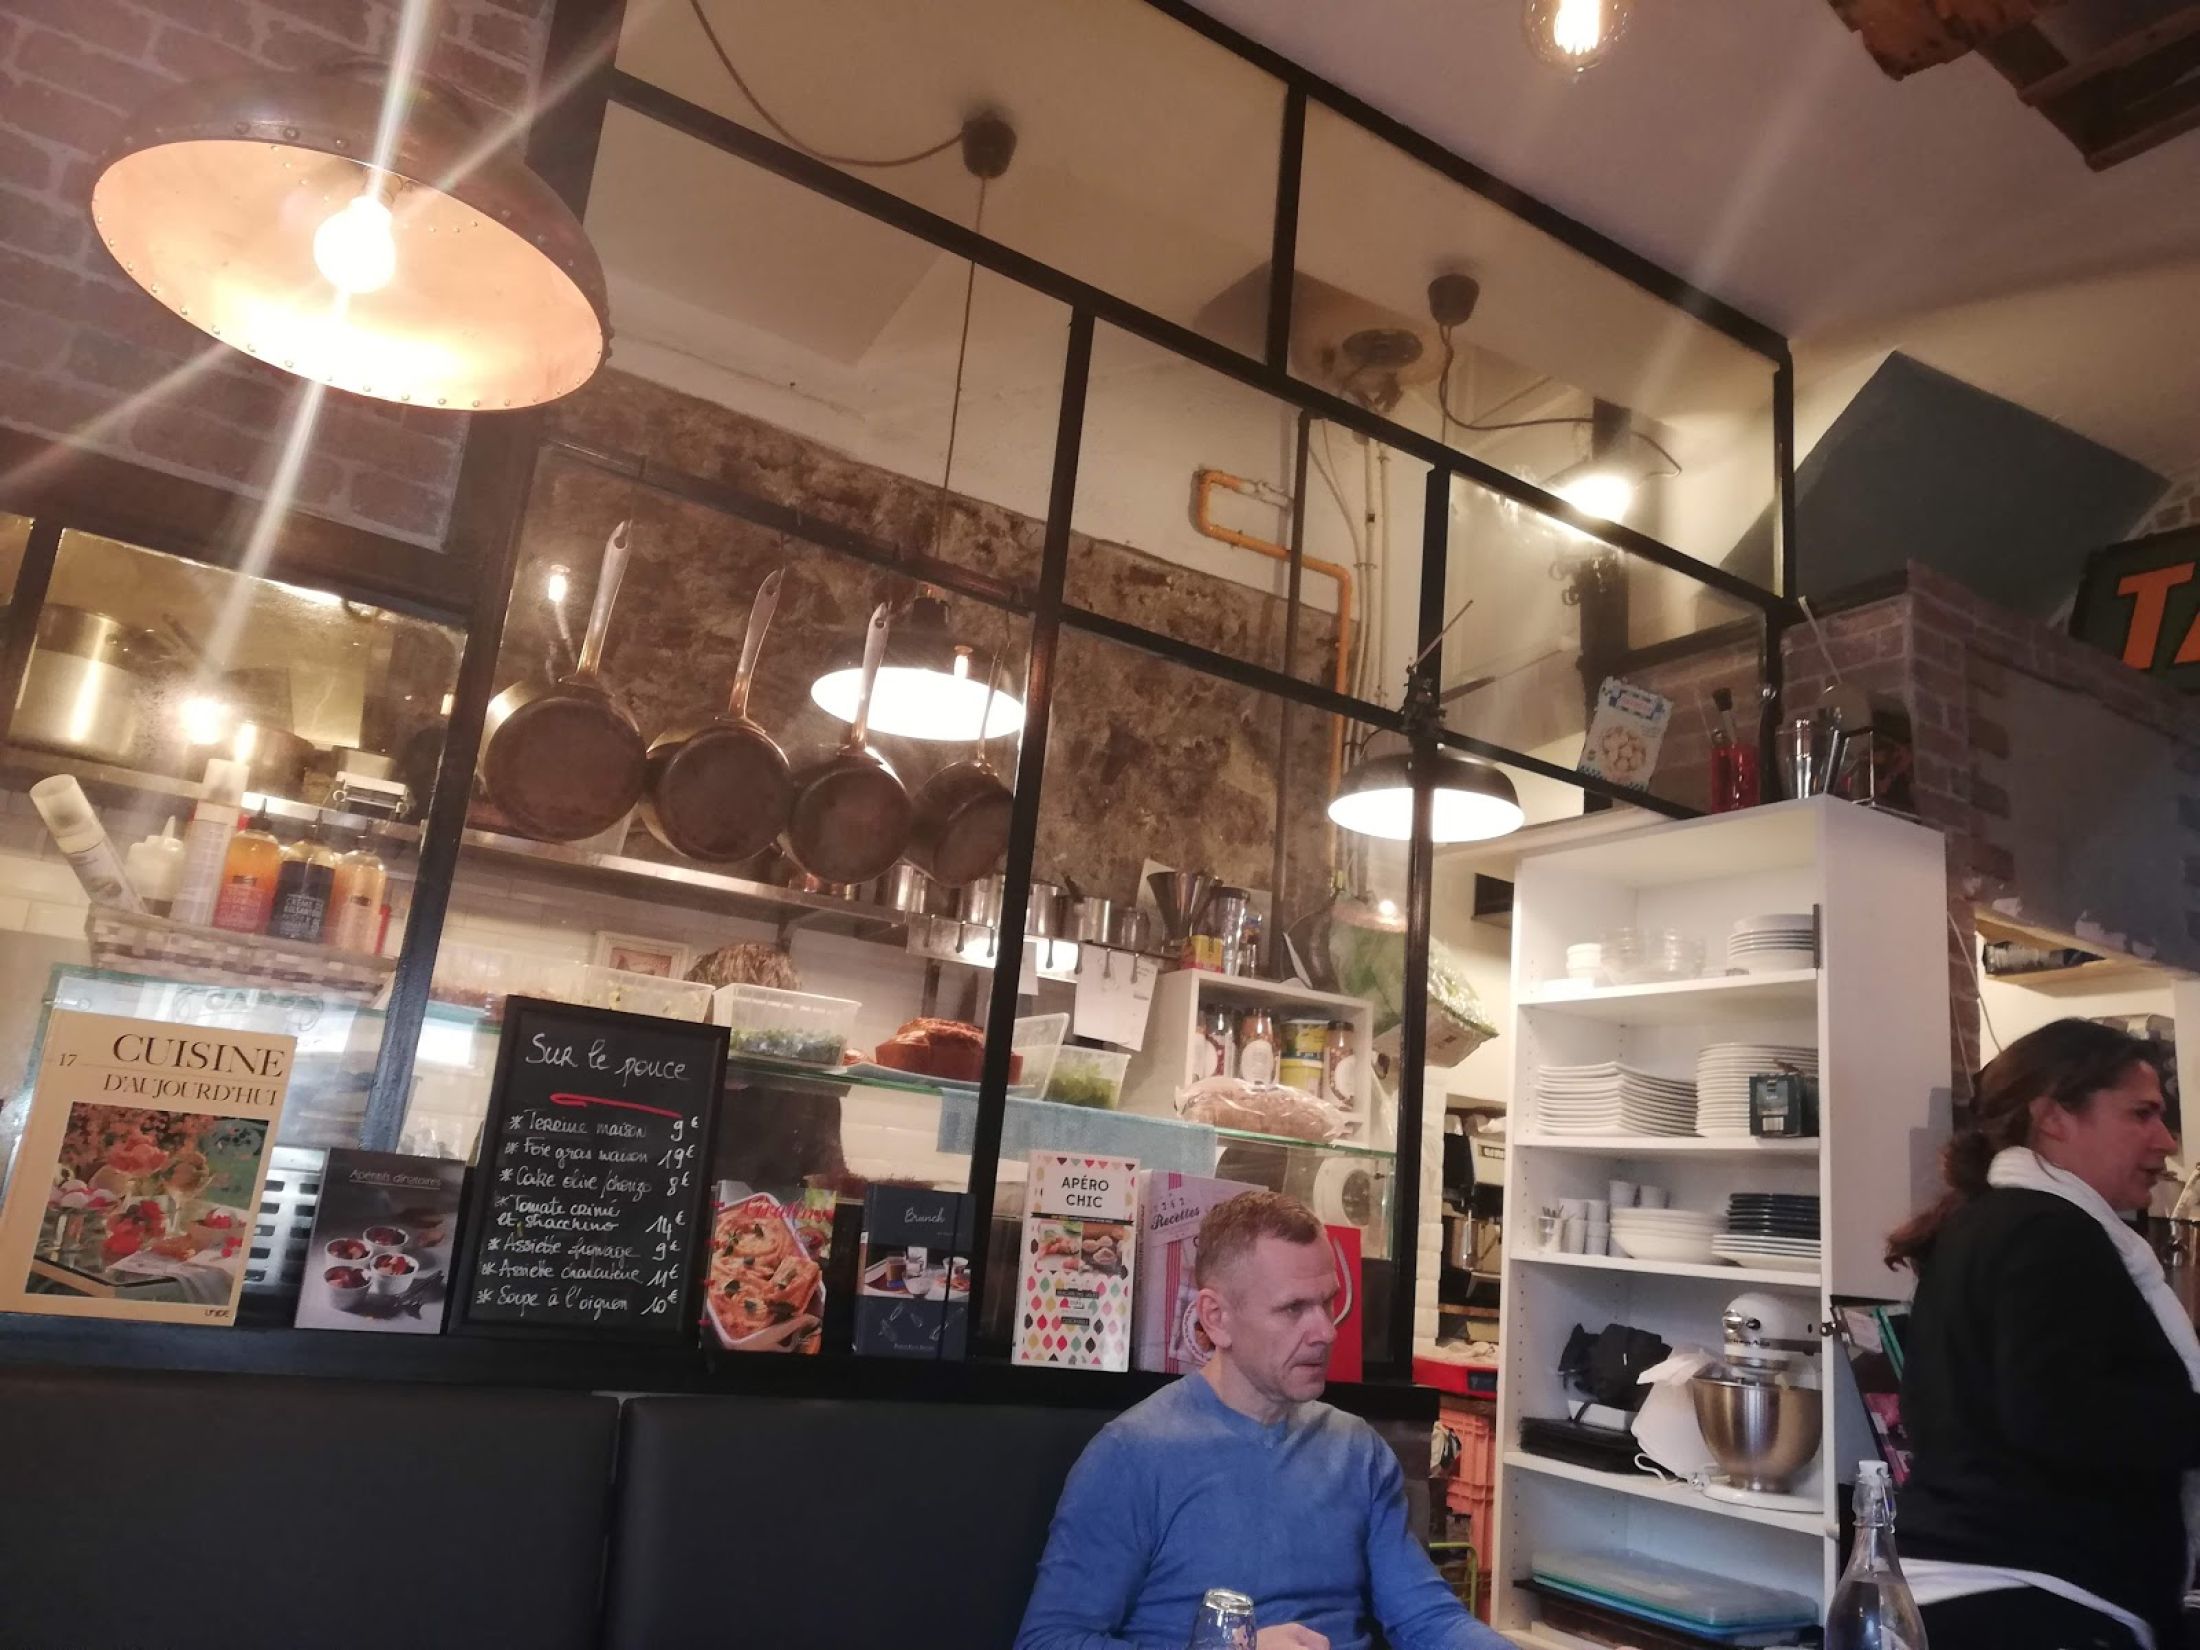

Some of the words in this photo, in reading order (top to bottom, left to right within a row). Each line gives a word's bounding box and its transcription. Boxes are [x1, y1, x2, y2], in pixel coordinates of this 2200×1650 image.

[58, 1053, 77, 1068] 17
[112, 1033, 285, 1078] CUISINE
[588, 1039, 609, 1071] le
[614, 1056, 692, 1088] pouce
[103, 1073, 278, 1106] D'AUJOURD'HUI
[597, 1122, 647, 1138] maison
[523, 1137, 551, 1157] Foie
[555, 1148, 592, 1169] gras
[599, 1150, 649, 1164] maison
[516, 1165, 556, 1188] Cake
[562, 1168, 599, 1190] olive
[1061, 1174, 1109, 1192] APÉRO
[510, 1194, 565, 1215] Tomate
[1066, 1194, 1103, 1209] CHIC
[496, 1212, 518, 1228] et
[904, 1206, 945, 1224] Brunch
[1150, 1206, 1200, 1230] Recettes
[504, 1232, 561, 1254] Assiette
[499, 1259, 554, 1279] Assiette
[497, 1284, 541, 1317] Soupe
[548, 1287, 559, 1307] à
